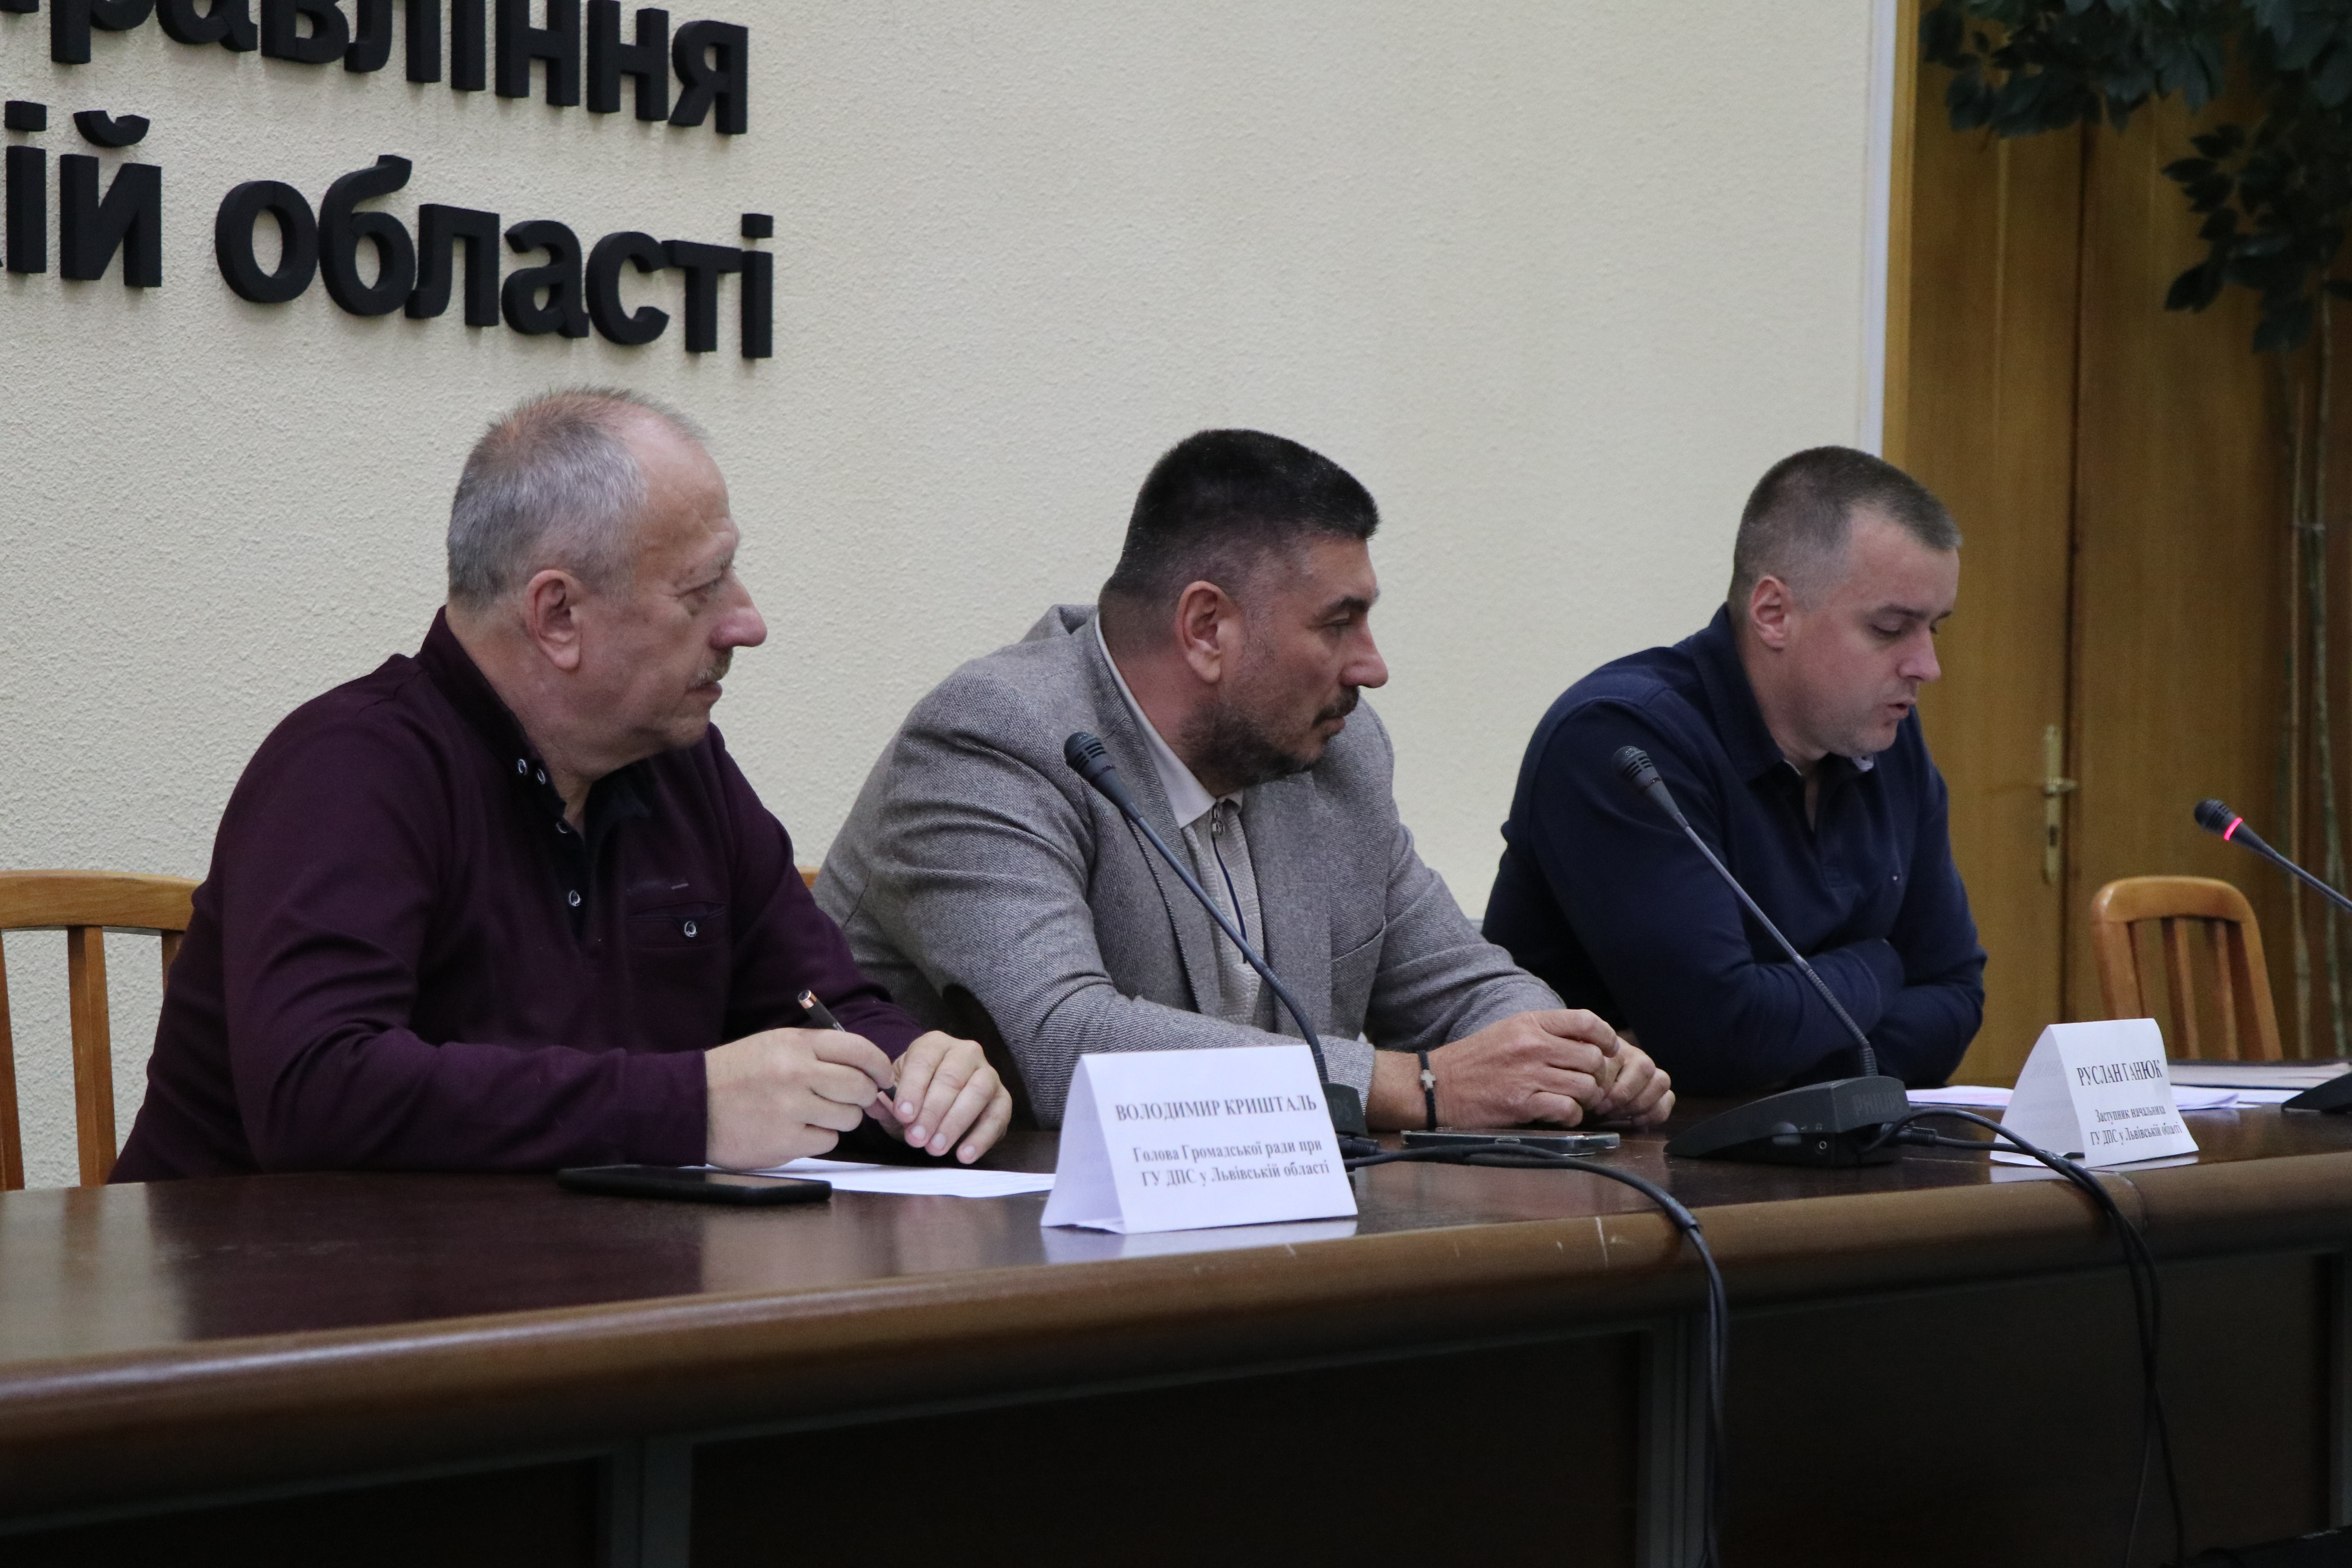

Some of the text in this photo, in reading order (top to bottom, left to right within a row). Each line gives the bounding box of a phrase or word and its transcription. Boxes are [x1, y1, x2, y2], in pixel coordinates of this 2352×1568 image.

[0, 0, 748, 134] вління
[0, 100, 773, 359] ій області
[2076, 1063, 2123, 1086] РУСЛАН
[2122, 1060, 2163, 1081] ГАНЮК
[1115, 1095, 1317, 1121] ВОЛОДИМИР КРИШТАЛЬ
[2095, 1105, 2166, 1125] Заступник начальника
[2090, 1131, 2100, 1145] ГУ
[2102, 1129, 2118, 1145] ДПС
[2119, 1132, 2123, 1145] у
[2124, 1124, 2162, 1141] Львівській
[1132, 1140, 1323, 1163] Голова Громадської ради при
[1142, 1159, 1330, 1187] ГУ ДПС у Львівській області
